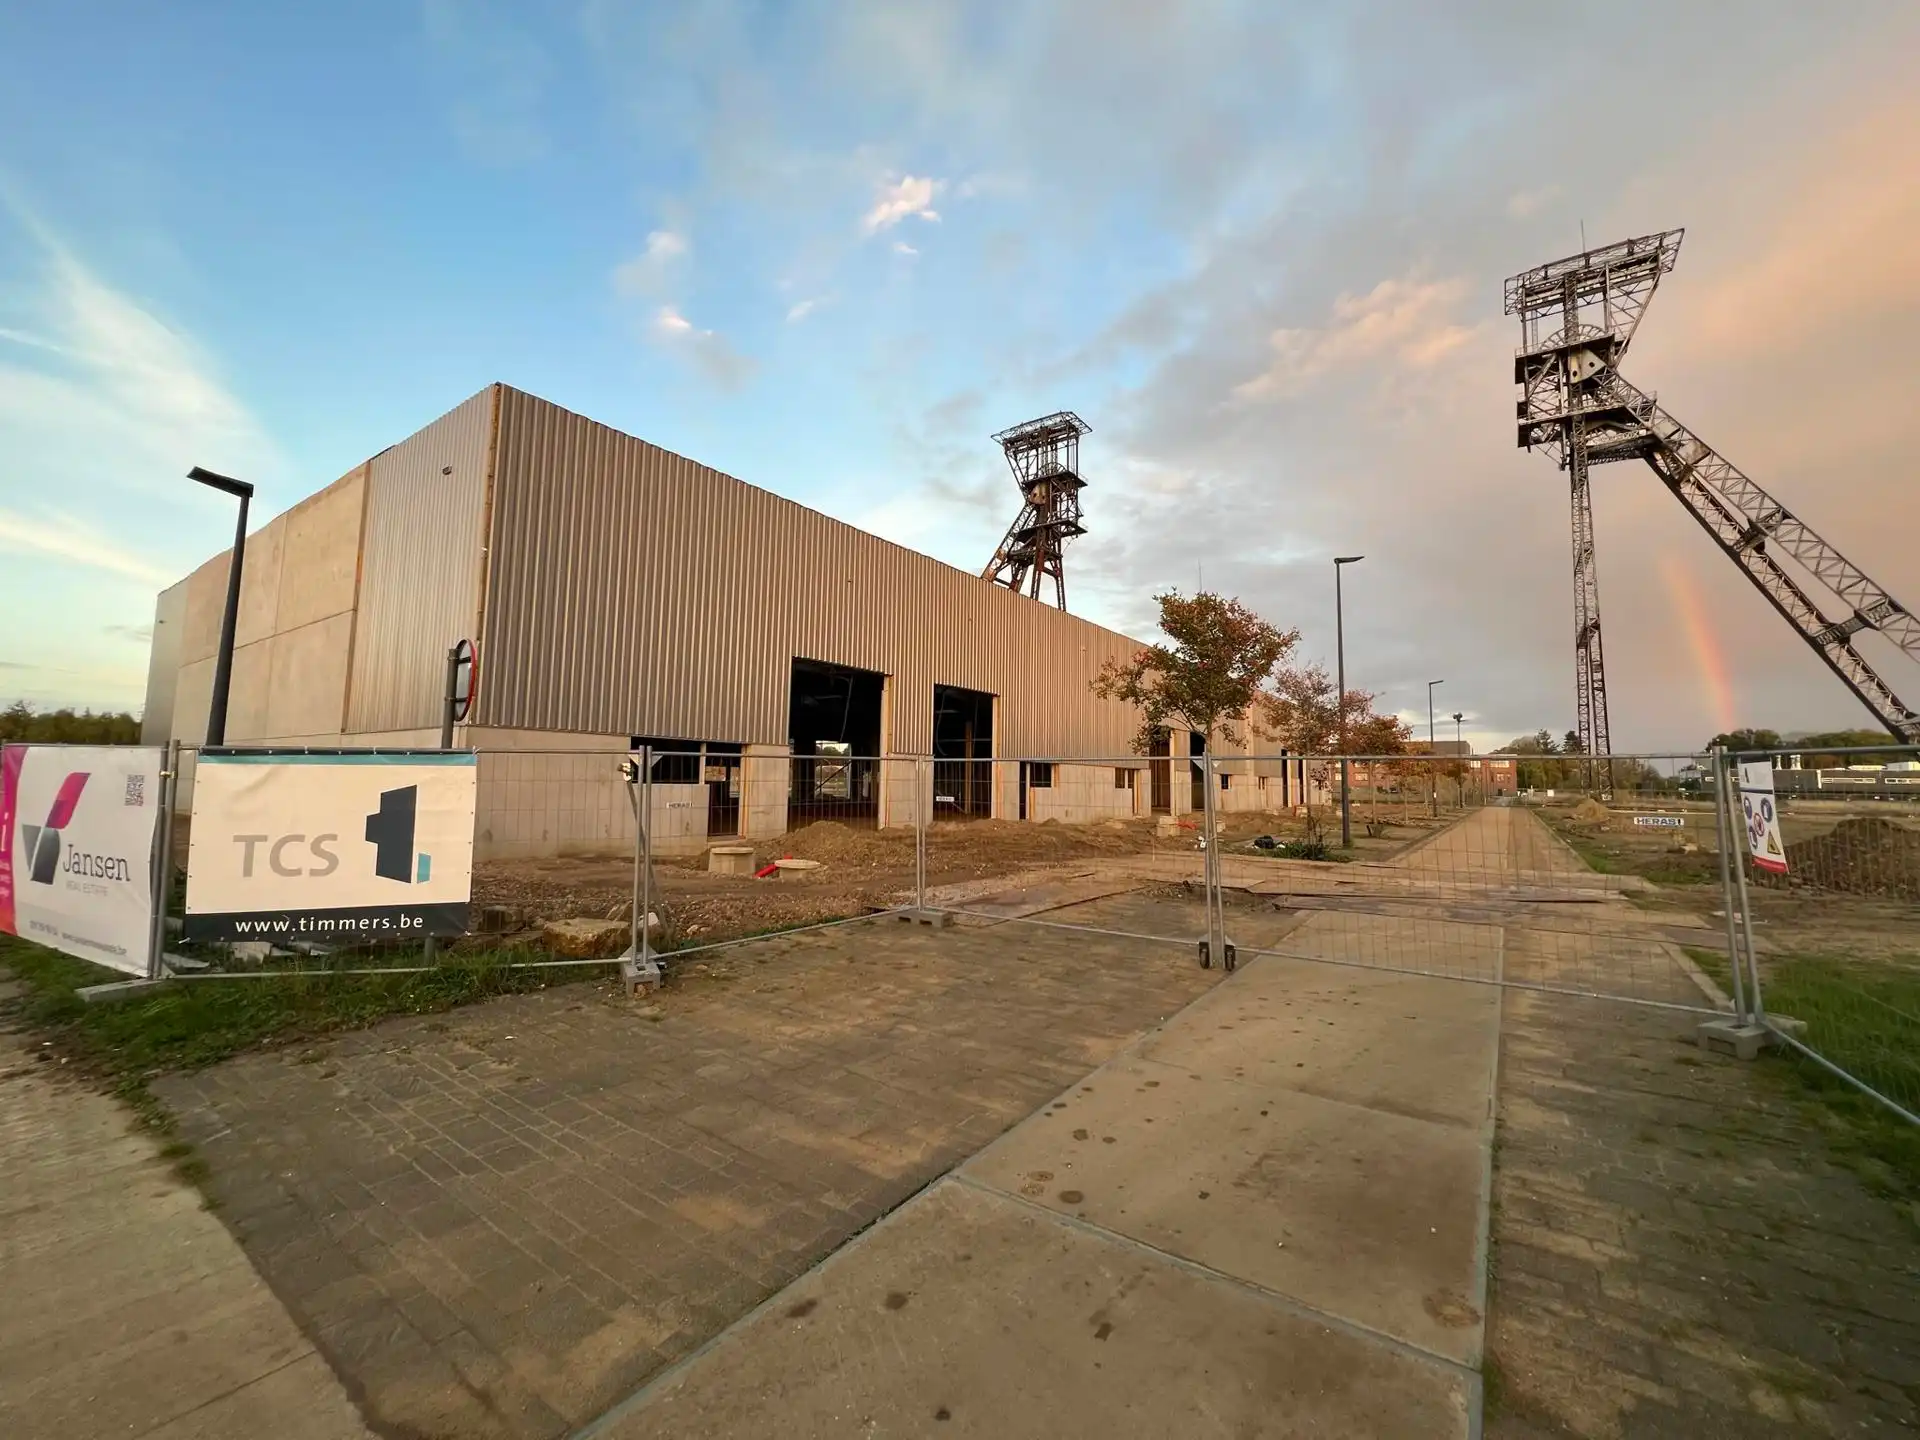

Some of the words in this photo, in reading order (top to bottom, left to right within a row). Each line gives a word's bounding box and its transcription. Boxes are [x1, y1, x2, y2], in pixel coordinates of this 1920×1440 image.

[63, 844, 131, 881] Jansen
[233, 834, 339, 877] TCS
[235, 914, 424, 932] www.timmers.be
